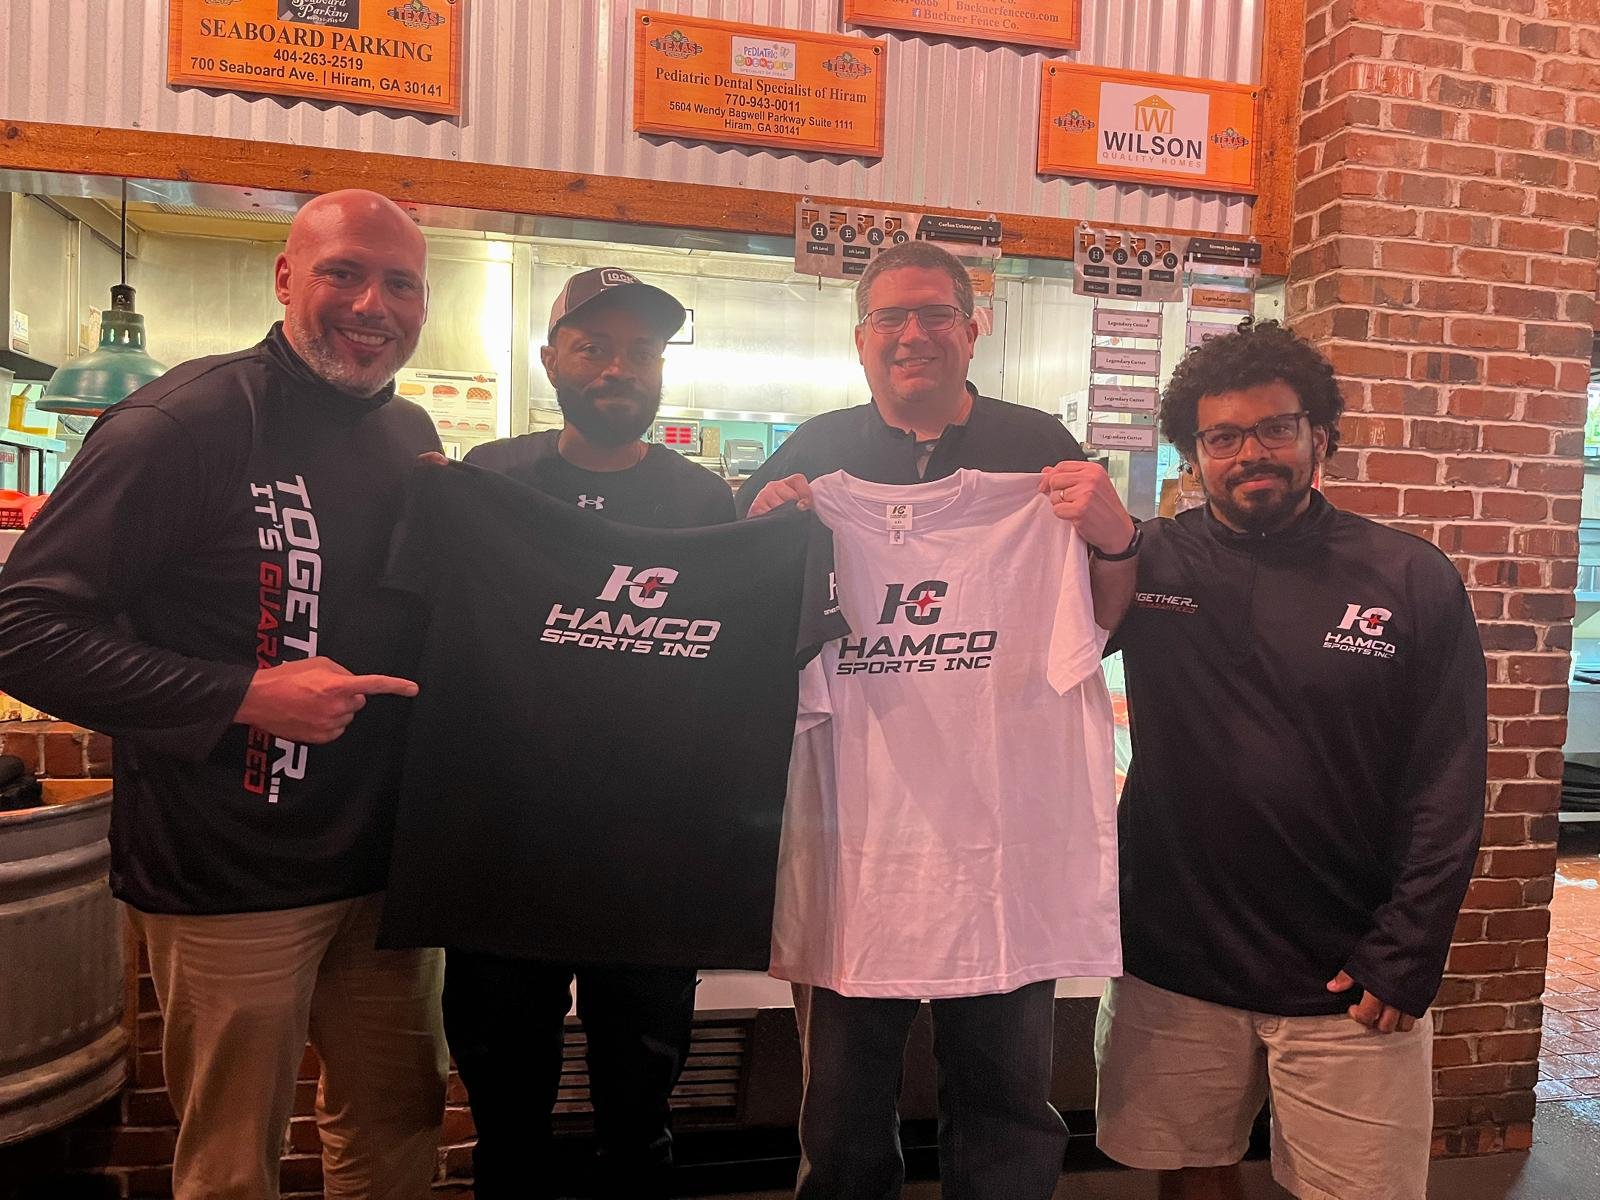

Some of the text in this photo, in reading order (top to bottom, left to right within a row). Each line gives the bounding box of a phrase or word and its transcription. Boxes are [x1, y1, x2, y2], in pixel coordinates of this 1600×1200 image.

[297, 3, 349, 22] Parking
[399, 8, 439, 26] TEXAS
[924, 9, 966, 23] Buckner
[970, 14, 1000, 27] Fence
[1002, 19, 1020, 29] Co.
[200, 17, 433, 62] SEABOARD PARKING
[659, 38, 697, 55] TEXAS
[273, 49, 363, 70] 404-263-2519
[190, 57, 215, 71] 700
[219, 59, 285, 78] Seaboard
[288, 67, 318, 82] Ave.
[331, 71, 375, 90] Hiram,
[379, 78, 401, 92] GA
[404, 80, 441, 97] 30141
[655, 67, 867, 103] Pediatric Dental Specialist of Hiram
[724, 93, 800, 113] 770-943-0011
[669, 101, 853, 130] 5604 Wendy Bagwell Parkway Suite 1111
[724, 118, 800, 136] Hiram, GA 30141
[1103, 130, 1202, 159] WILSON
[1102, 151, 1201, 169] QUALITY HOMES
[250, 482, 283, 551] IT'S
[545, 603, 721, 642] HAMCO
[539, 628, 711, 659] SPORTS INC
[838, 630, 998, 659] HAMCO
[1322, 641, 1394, 659] SPORTS INC
[1324, 632, 1396, 654] HAMCO
[836, 656, 992, 675] SPORTS INC
